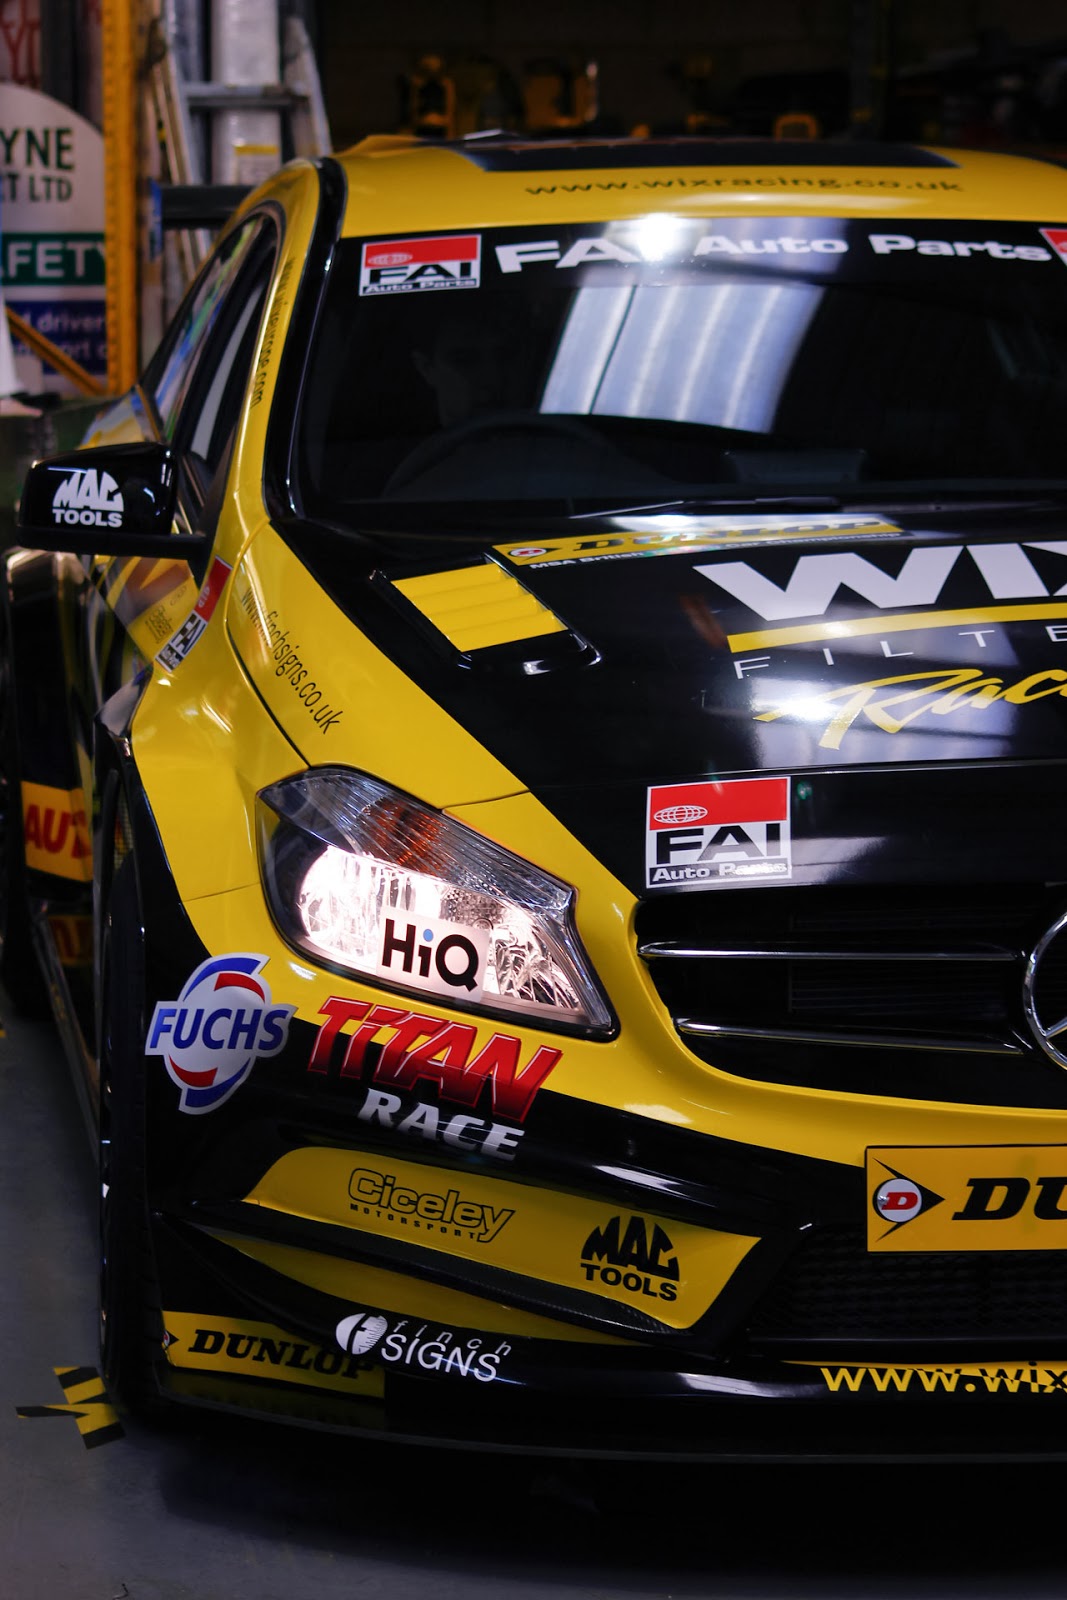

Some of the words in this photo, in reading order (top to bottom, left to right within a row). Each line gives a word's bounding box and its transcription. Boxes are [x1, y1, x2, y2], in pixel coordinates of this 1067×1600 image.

[29, 174, 73, 202] LTD
[525, 177, 964, 195] www.wixracing.co.uk
[369, 261, 472, 285] FAI
[495, 237, 642, 274] FA
[695, 235, 849, 257] Auto
[868, 234, 1052, 262] Parts
[52, 468, 124, 512] MAC
[52, 508, 123, 528] TOOLS
[530, 558, 576, 570] MSA
[578, 551, 645, 563] British
[753, 667, 1067, 752] Rac
[656, 822, 781, 865] FAI
[652, 867, 711, 882] Auto
[382, 918, 480, 992] HiQ
[150, 1008, 290, 1051] FUCHS
[357, 1087, 525, 1162] RACE
[348, 1168, 516, 1243] Ciceley
[350, 1202, 476, 1240] MOTORSPORT
[580, 1215, 681, 1282] MAC
[580, 1262, 678, 1301] TOOLS
[187, 1328, 375, 1380] DUNLOP
[380, 1333, 501, 1383] SIGNS
[393, 1319, 513, 1357] finch
